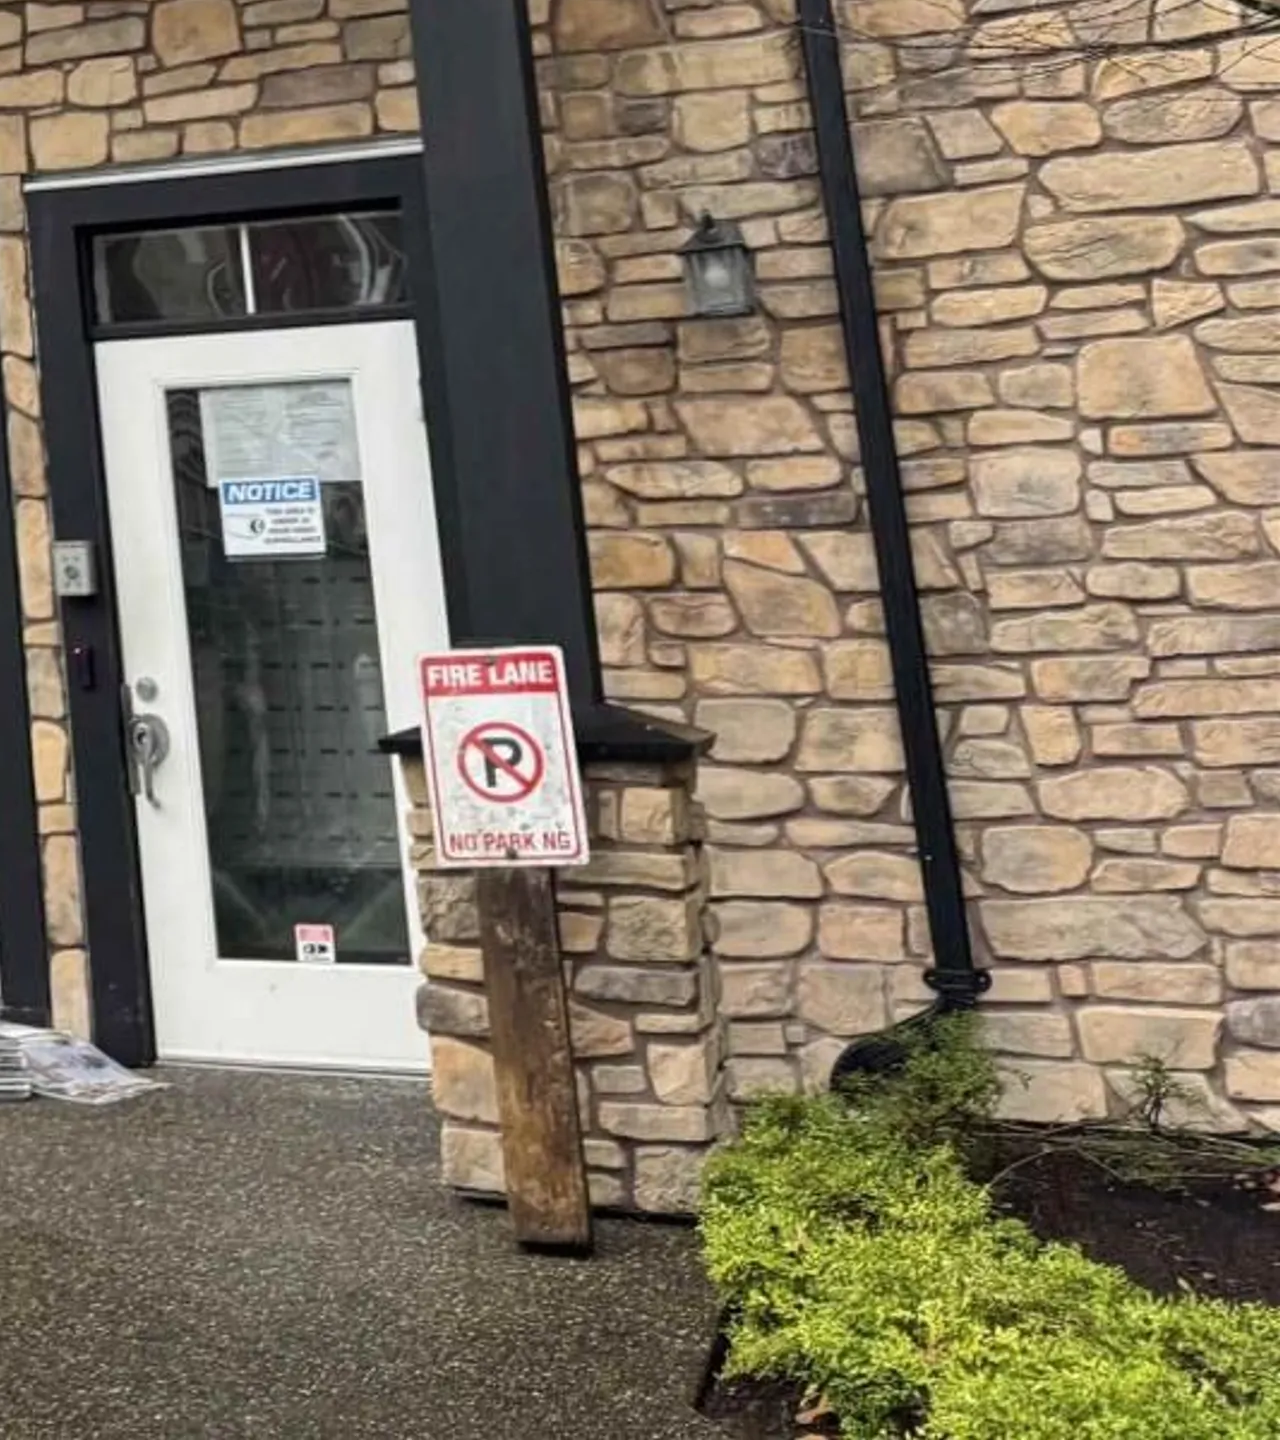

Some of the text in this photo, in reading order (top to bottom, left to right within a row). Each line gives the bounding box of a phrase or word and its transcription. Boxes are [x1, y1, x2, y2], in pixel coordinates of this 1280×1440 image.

[228, 480, 313, 502] NOTICE
[427, 660, 555, 689] FIRE LANE
[449, 830, 571, 853] NO PARKNG
